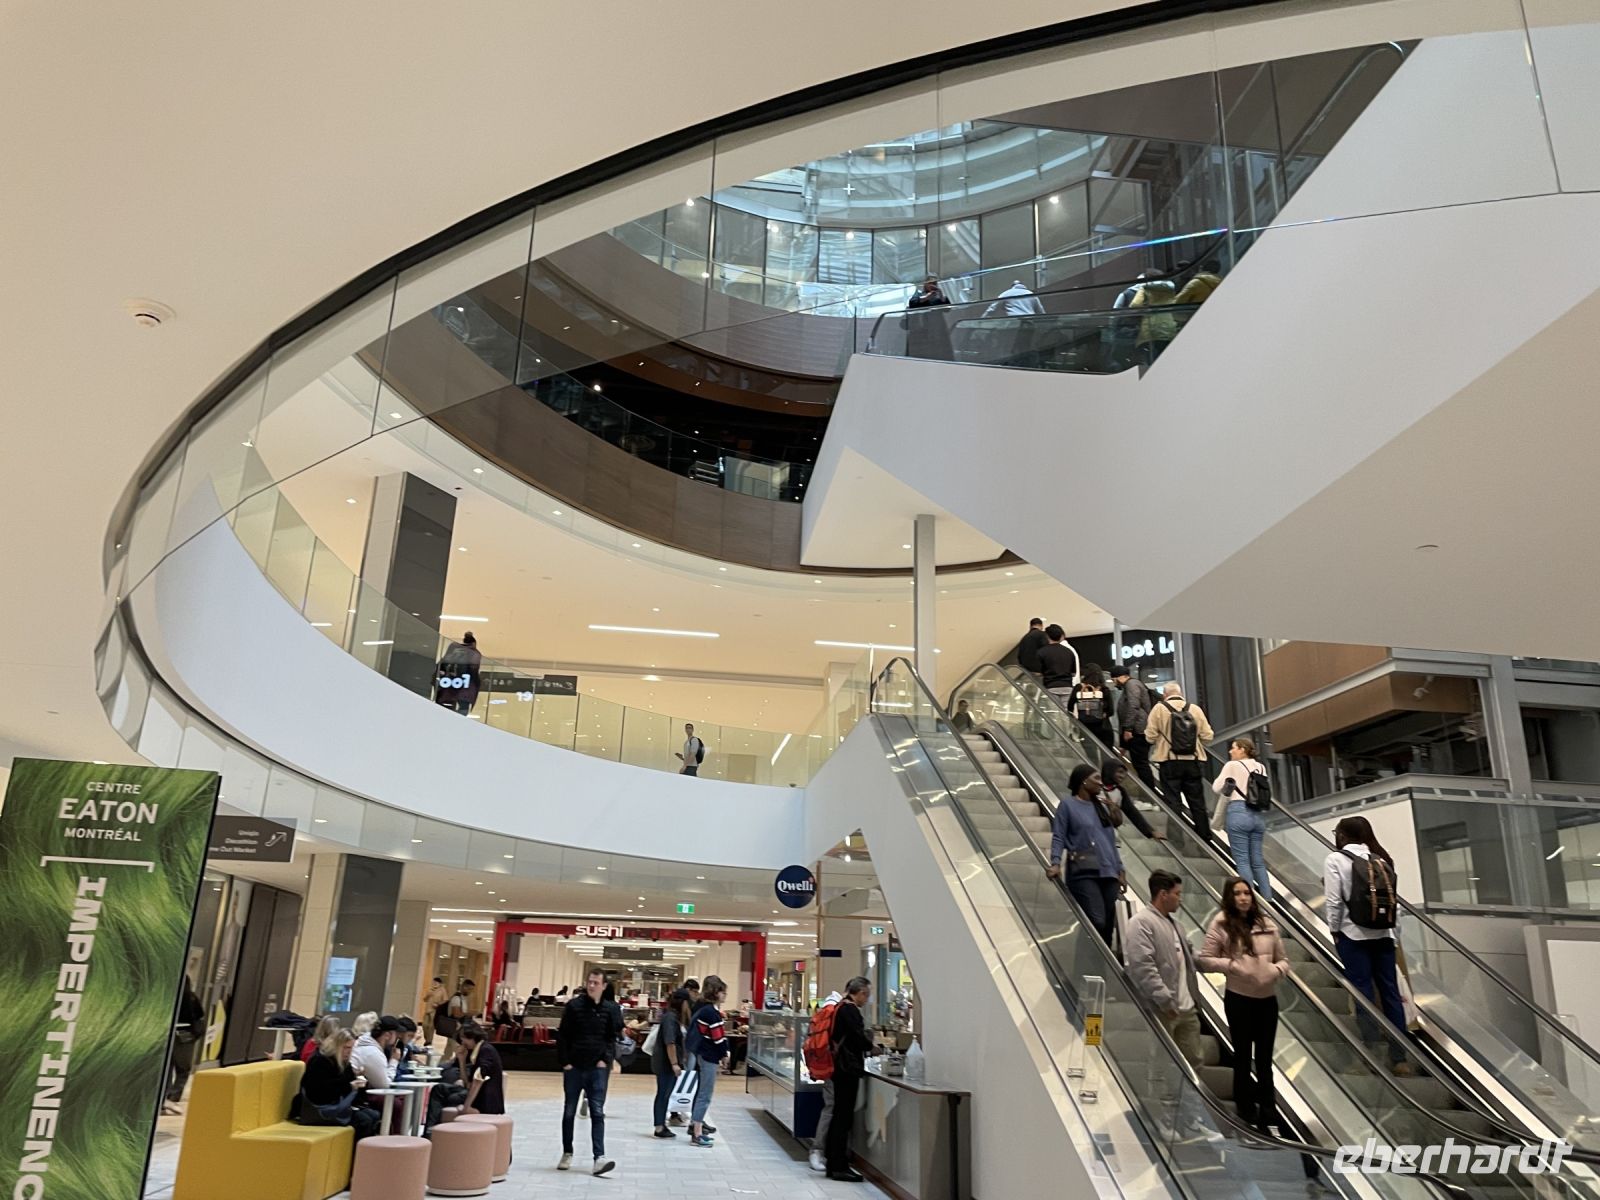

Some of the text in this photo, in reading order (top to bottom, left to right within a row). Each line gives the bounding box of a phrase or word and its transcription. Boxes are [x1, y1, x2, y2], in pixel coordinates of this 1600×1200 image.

[86, 781, 142, 794] CENTRE
[58, 797, 159, 824] EATON
[63, 827, 142, 842] MONTRÉAL
[777, 876, 815, 893] Qwelli
[575, 924, 624, 937] sushi
[13, 876, 107, 1200] IMPERTINENC
